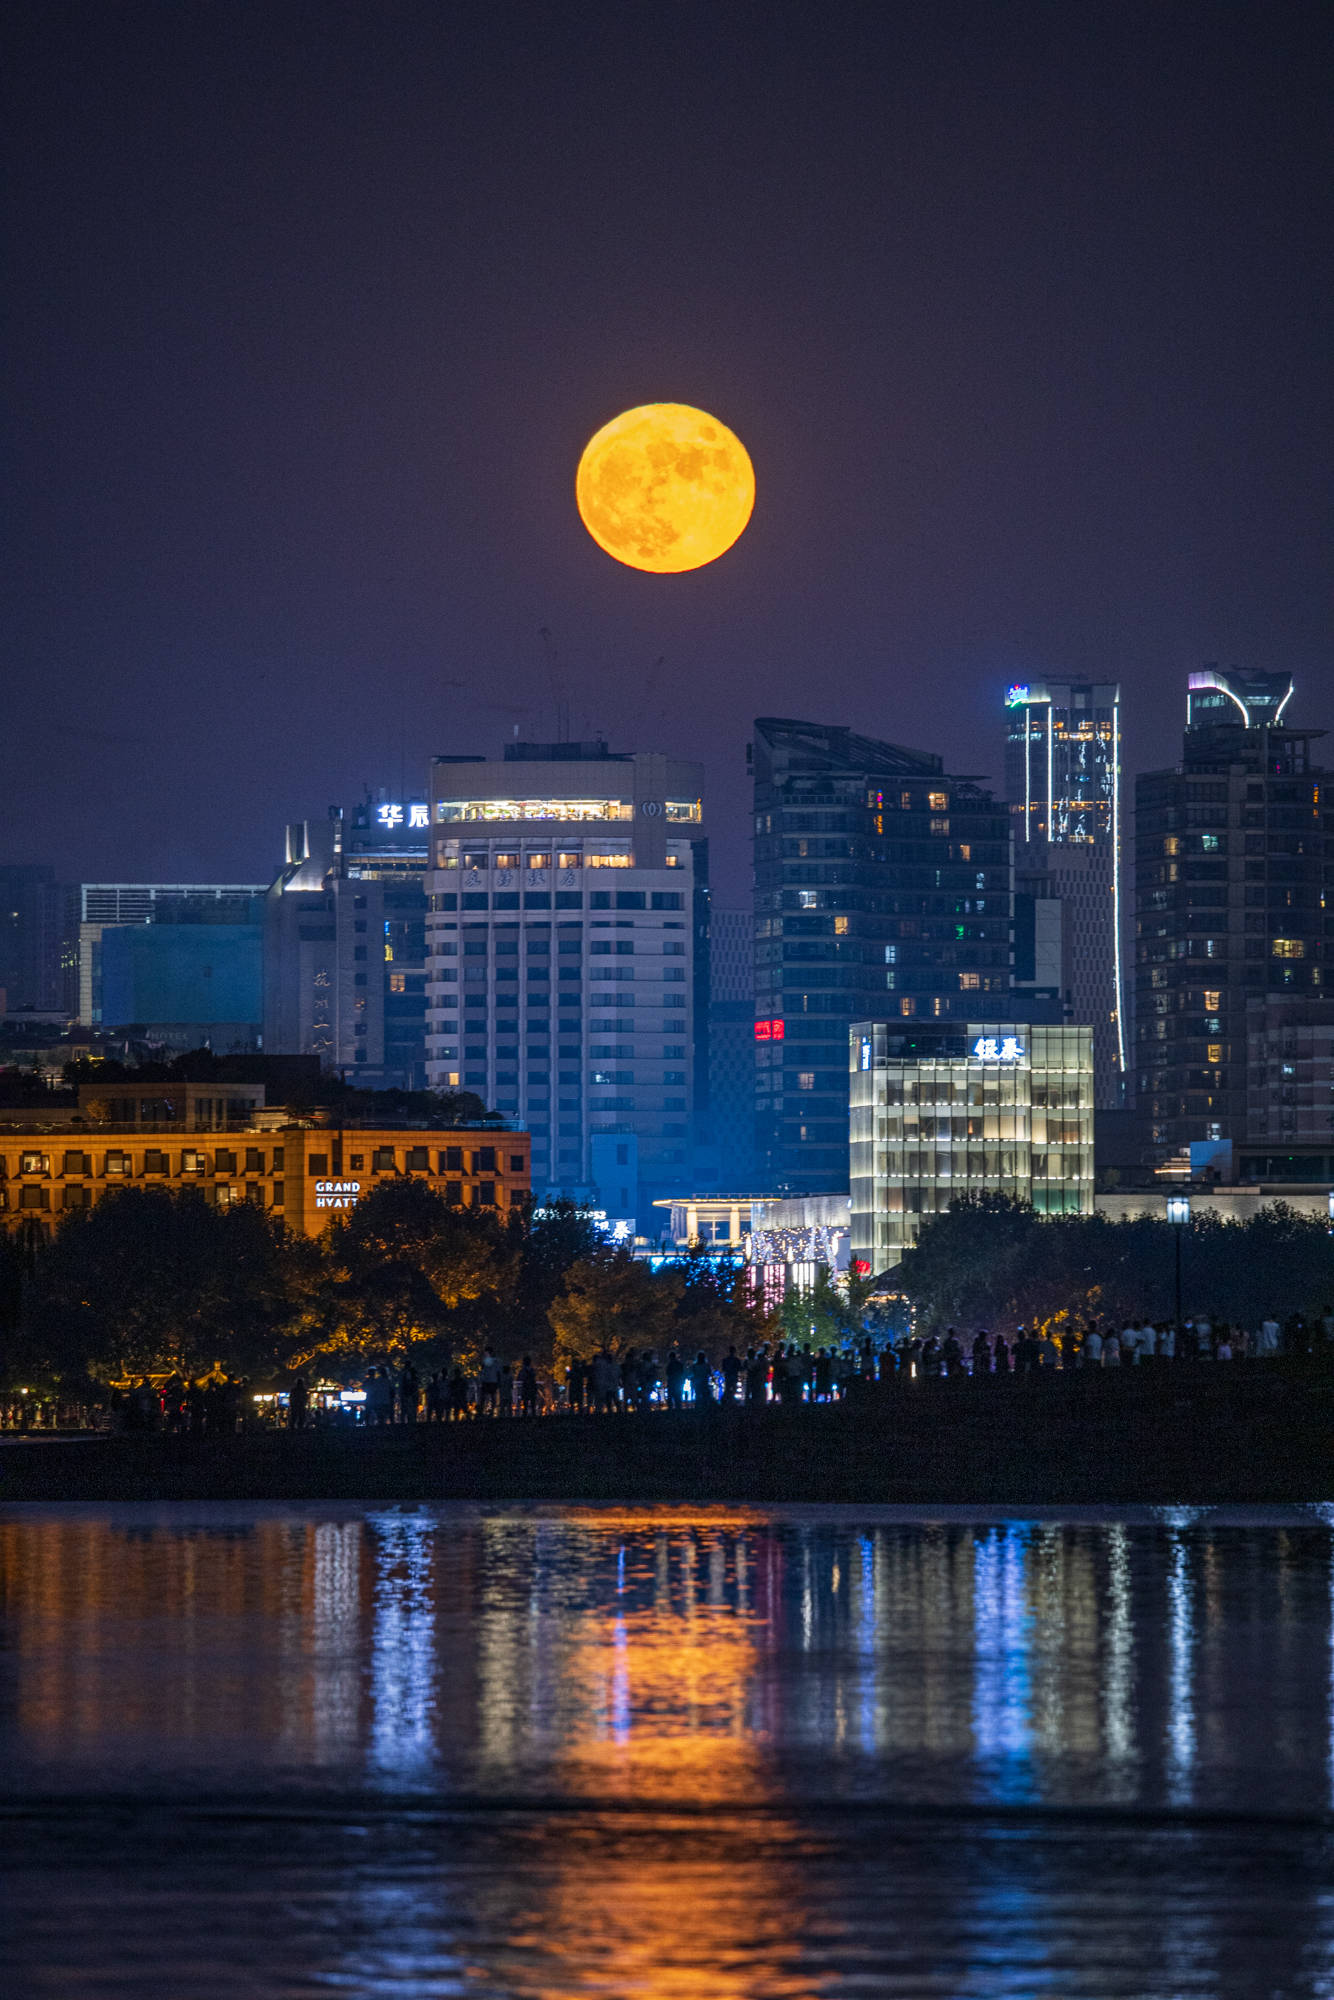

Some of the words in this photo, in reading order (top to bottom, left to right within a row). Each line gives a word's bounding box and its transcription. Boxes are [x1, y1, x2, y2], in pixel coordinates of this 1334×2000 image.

[377, 804, 430, 829] 华辰
[974, 1037, 1025, 1060] 银泰
[315, 1182, 361, 1192] GRAND
[316, 1197, 360, 1208] HYATT
